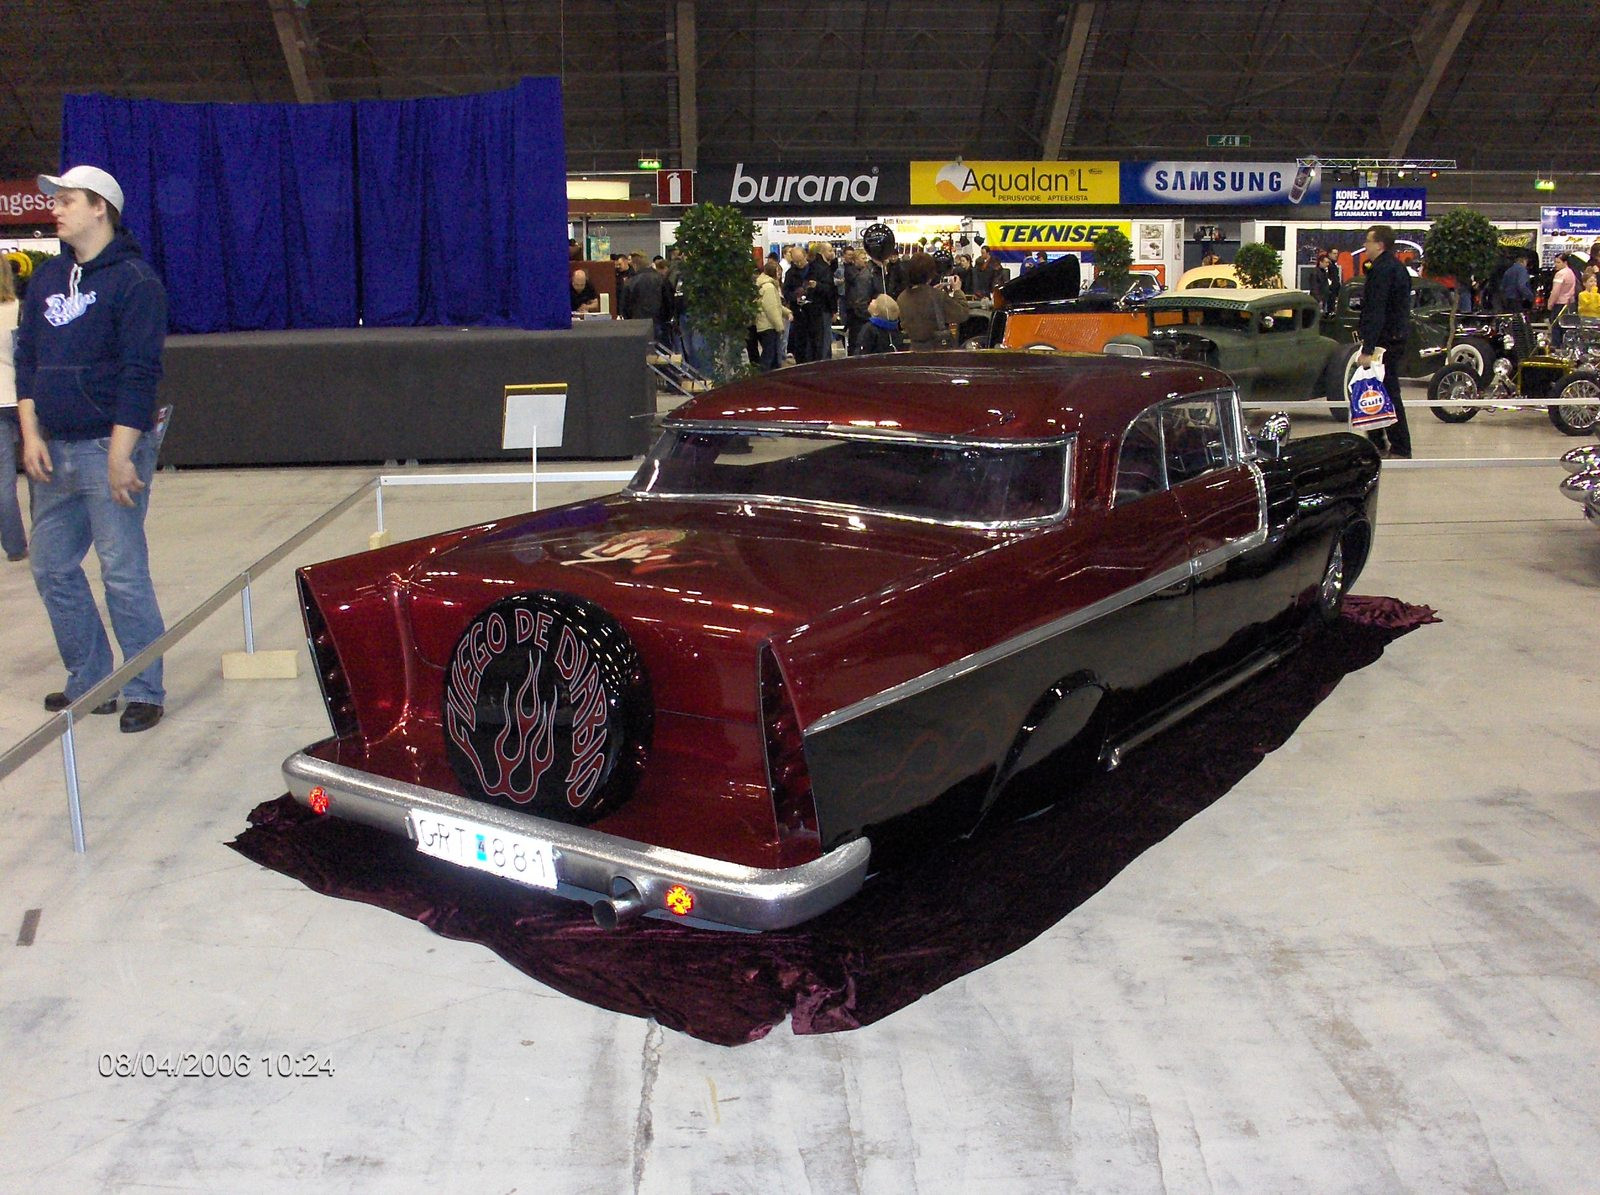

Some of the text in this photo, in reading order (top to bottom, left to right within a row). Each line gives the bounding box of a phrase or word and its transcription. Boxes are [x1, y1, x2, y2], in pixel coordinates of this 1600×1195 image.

[730, 163, 878, 203] burana
[962, 167, 1088, 197] Aqualan L
[1155, 170, 1282, 192] SAMSUNG
[998, 194, 1088, 202] PERUSVOIDE APTEEKISTA
[1334, 200, 1423, 210] RADIOKULMA
[514, 608, 554, 652] DE
